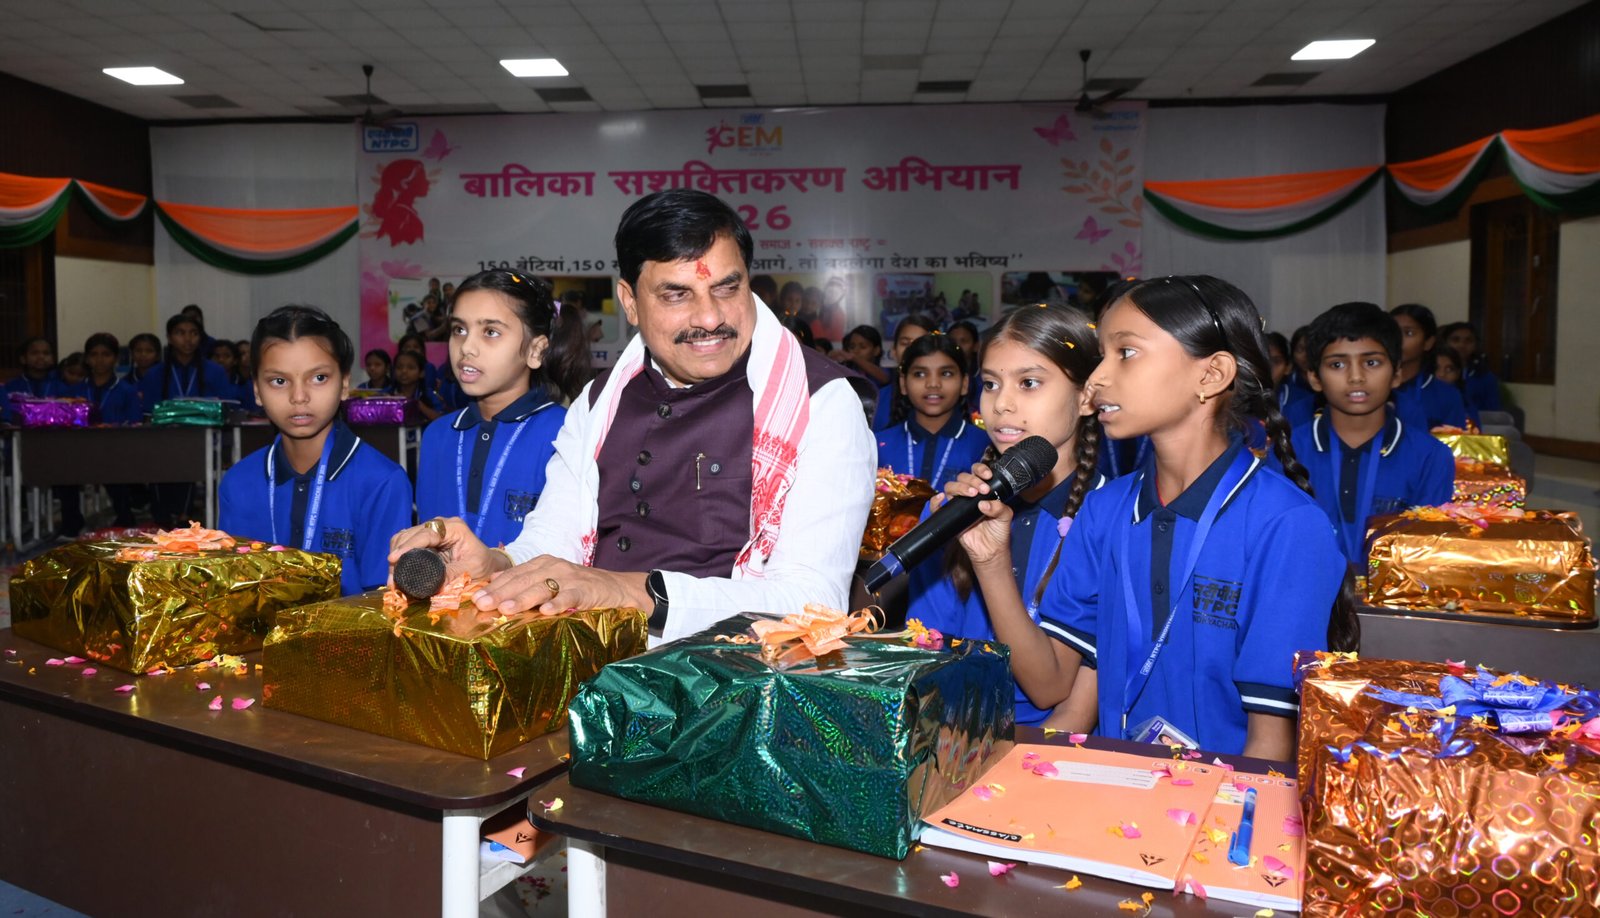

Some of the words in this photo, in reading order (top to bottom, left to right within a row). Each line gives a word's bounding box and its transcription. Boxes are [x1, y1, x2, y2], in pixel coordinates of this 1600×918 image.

[371, 139, 411, 149] NTPC
[718, 125, 783, 148] GEM
[459, 163, 596, 198] बालिका
[607, 159, 847, 197] सशक्तिकरण
[861, 156, 1022, 192] अभियान
[738, 204, 792, 231] 26
[890, 252, 919, 268] देश
[924, 256, 948, 268] का
[1150, 642, 1162, 659] NTPC
[1158, 604, 1178, 642] VINDHYAC
